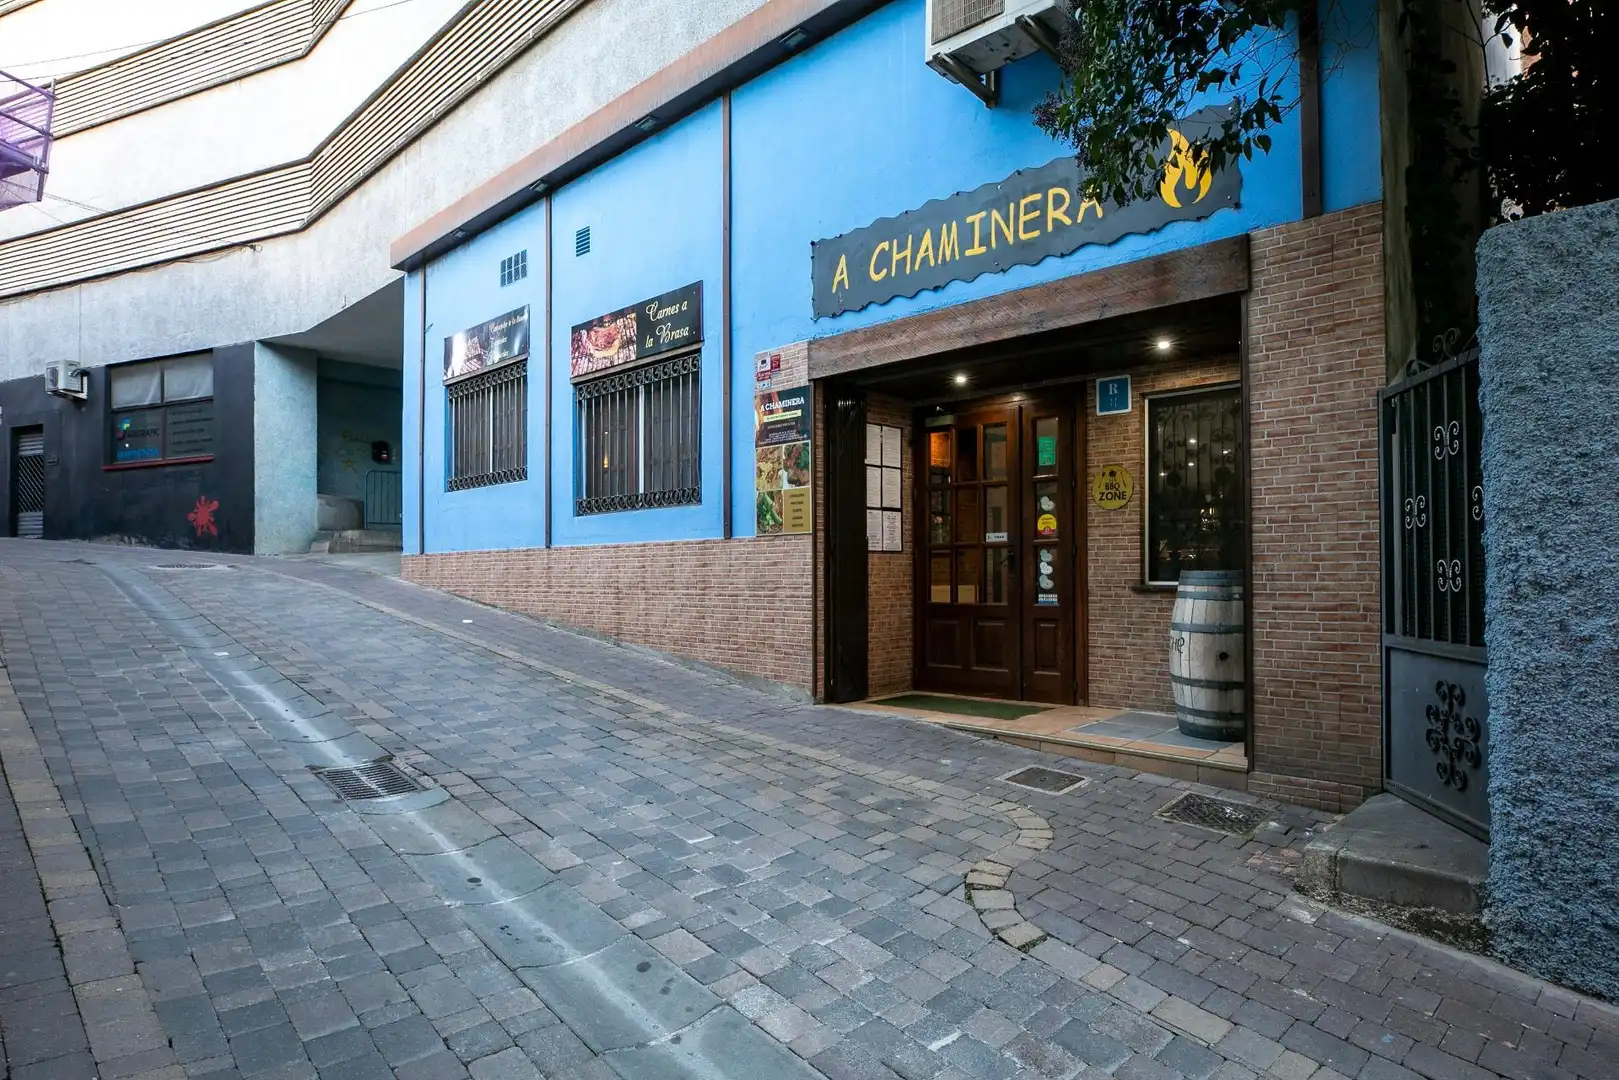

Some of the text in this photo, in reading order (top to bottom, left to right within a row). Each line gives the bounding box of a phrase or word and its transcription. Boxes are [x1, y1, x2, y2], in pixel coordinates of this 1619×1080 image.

[832, 186, 1104, 293] A CHAMINERA
[645, 301, 688, 322] Carnes a
[645, 322, 690, 348] la Brasa
[1109, 383, 1118, 395] R
[1105, 482, 1120, 491] BBQ
[1099, 490, 1127, 501] ZONE
